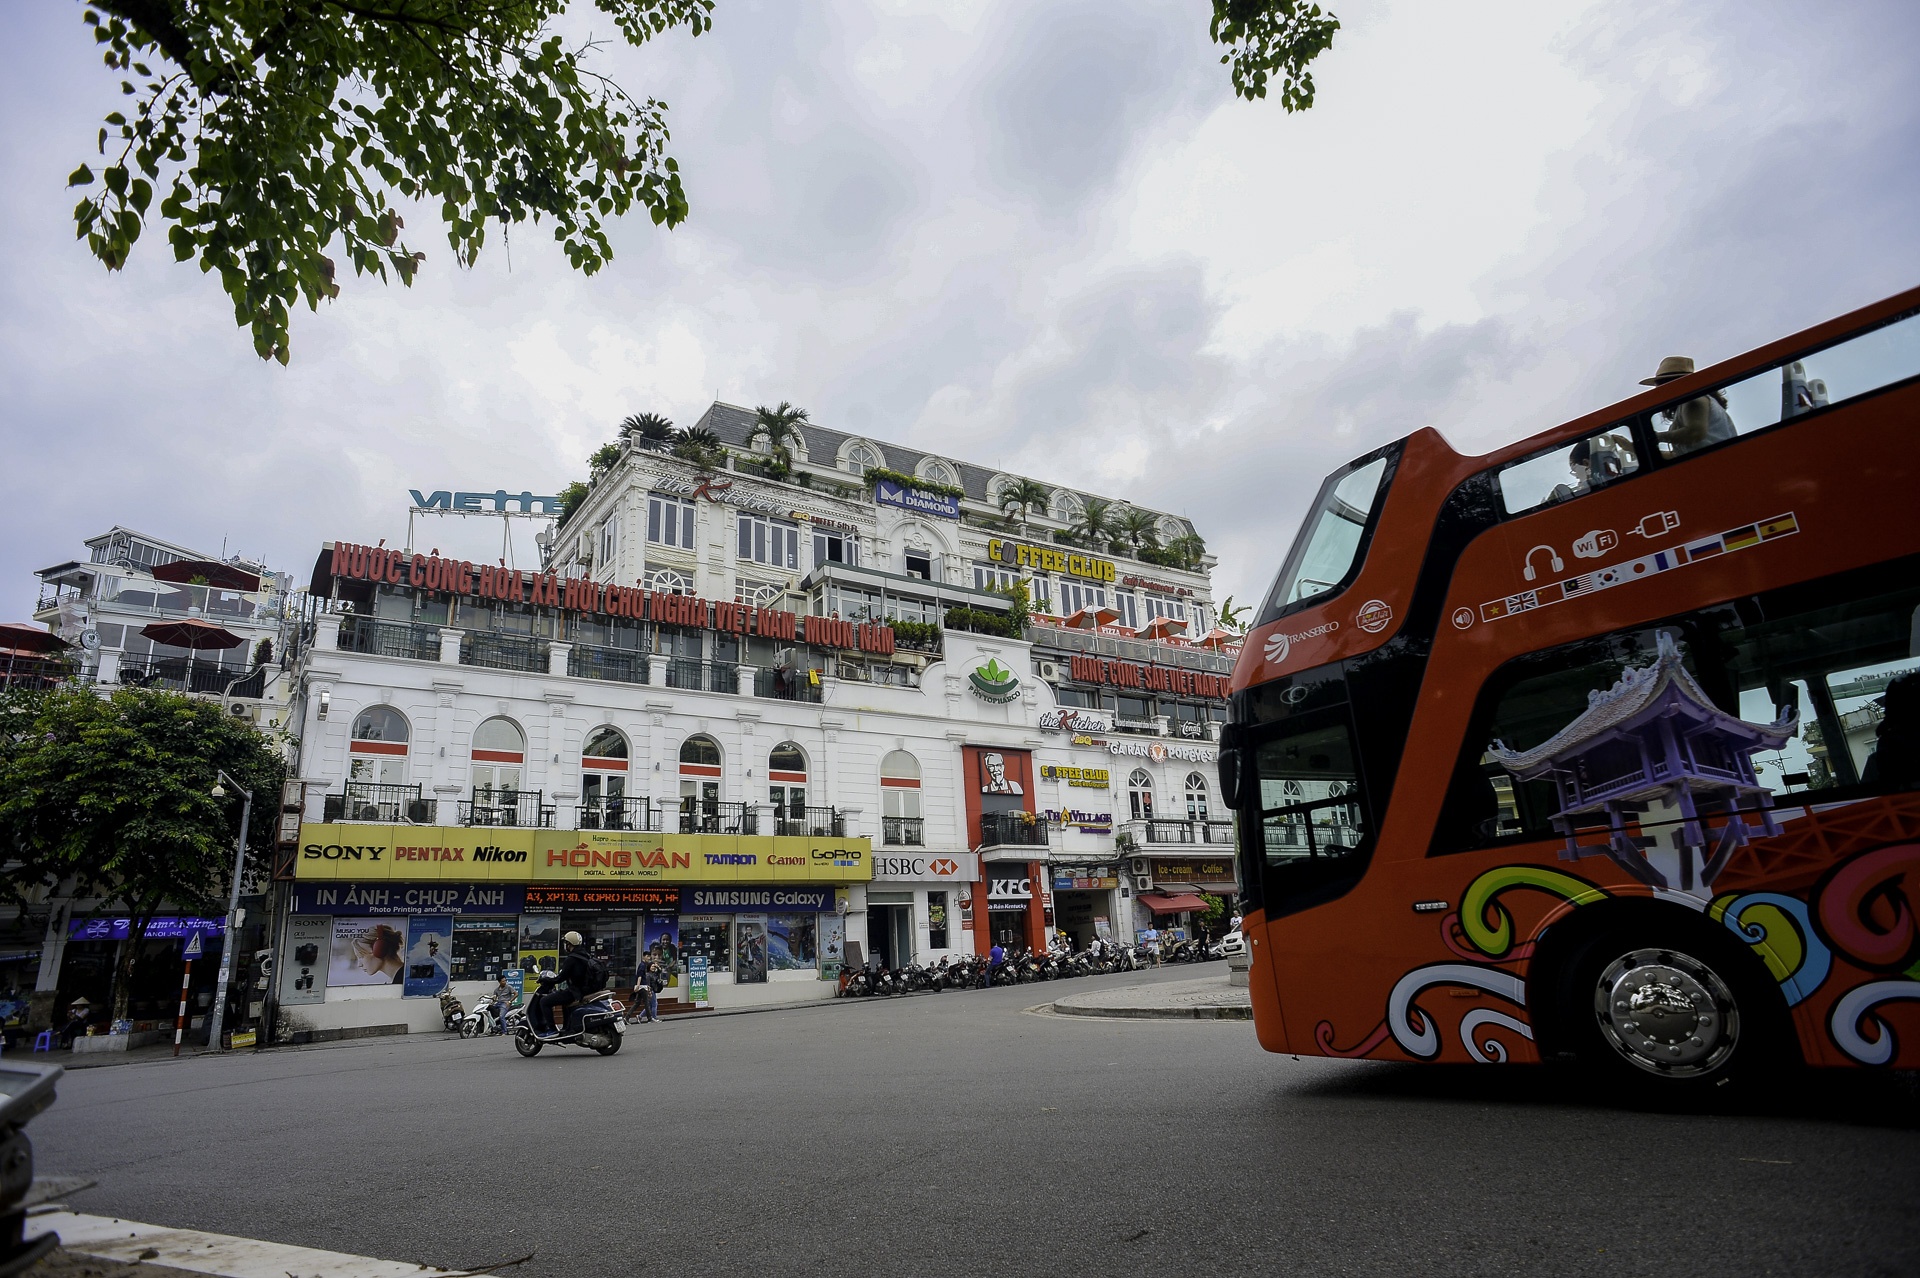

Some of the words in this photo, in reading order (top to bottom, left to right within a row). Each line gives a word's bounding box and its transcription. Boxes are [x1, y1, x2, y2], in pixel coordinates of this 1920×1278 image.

[409, 489, 563, 514] VIETTE
[654, 477, 692, 496] the
[692, 476, 787, 518] Kitchen
[905, 496, 956, 515] DIAMOND
[1577, 541, 1593, 553] Wi
[1599, 535, 1612, 546] Fi
[1068, 555, 1116, 582] CLUB
[331, 538, 403, 585] NƯỚC
[410, 547, 473, 598] CỘNG
[479, 558, 523, 603] HÒA
[530, 566, 559, 607] XÃ
[564, 571, 599, 618] HỘI
[605, 579, 644, 619] CHỦ
[650, 589, 708, 629] NGHĨA
[715, 596, 753, 639] VIỆT
[757, 607, 796, 641] NAM
[804, 609, 854, 649] MUÔN
[858, 617, 895, 656] NĂM
[1101, 627, 1121, 636] PIZZA
[1293, 621, 1344, 644] TRANSERCO
[1070, 649, 1107, 684] ĐẢNG
[1107, 656, 1141, 691] CỘNG
[1143, 659, 1168, 690] SẢN
[1168, 664, 1193, 698] VIỆT
[1193, 673, 1218, 698] NAM
[968, 685, 1021, 705] PHYTOPHARCO
[1040, 712, 1060, 728] the
[1058, 709, 1106, 731] Kitchen
[1074, 735, 1092, 745] BBQ
[1110, 741, 1126, 755] GÀ
[1127, 743, 1148, 757] RÁN
[1082, 768, 1109, 780] CLUB
[304, 845, 386, 861] SONY
[395, 847, 464, 862] PENTAX
[472, 846, 528, 863] Nikon
[547, 843, 632, 868] HỒNG
[636, 847, 690, 869] VÂN
[703, 854, 757, 866] TAMRON
[767, 855, 806, 866] Canon
[811, 849, 862, 860] GoPro
[876, 858, 925, 875] HSBC
[1202, 864, 1223, 874] Coffee
[317, 890, 337, 905] IN
[344, 885, 389, 905] ẢNH
[405, 890, 458, 907] CHỤP
[463, 886, 505, 906] ẢNH
[990, 879, 1031, 895] KFC
[583, 893, 620, 902] GOPRO
[694, 892, 769, 905] SAMSUNG
[773, 893, 824, 907] Galaxy
[690, 971, 706, 980] CHỤP
[692, 978, 705, 987] ẢNH
